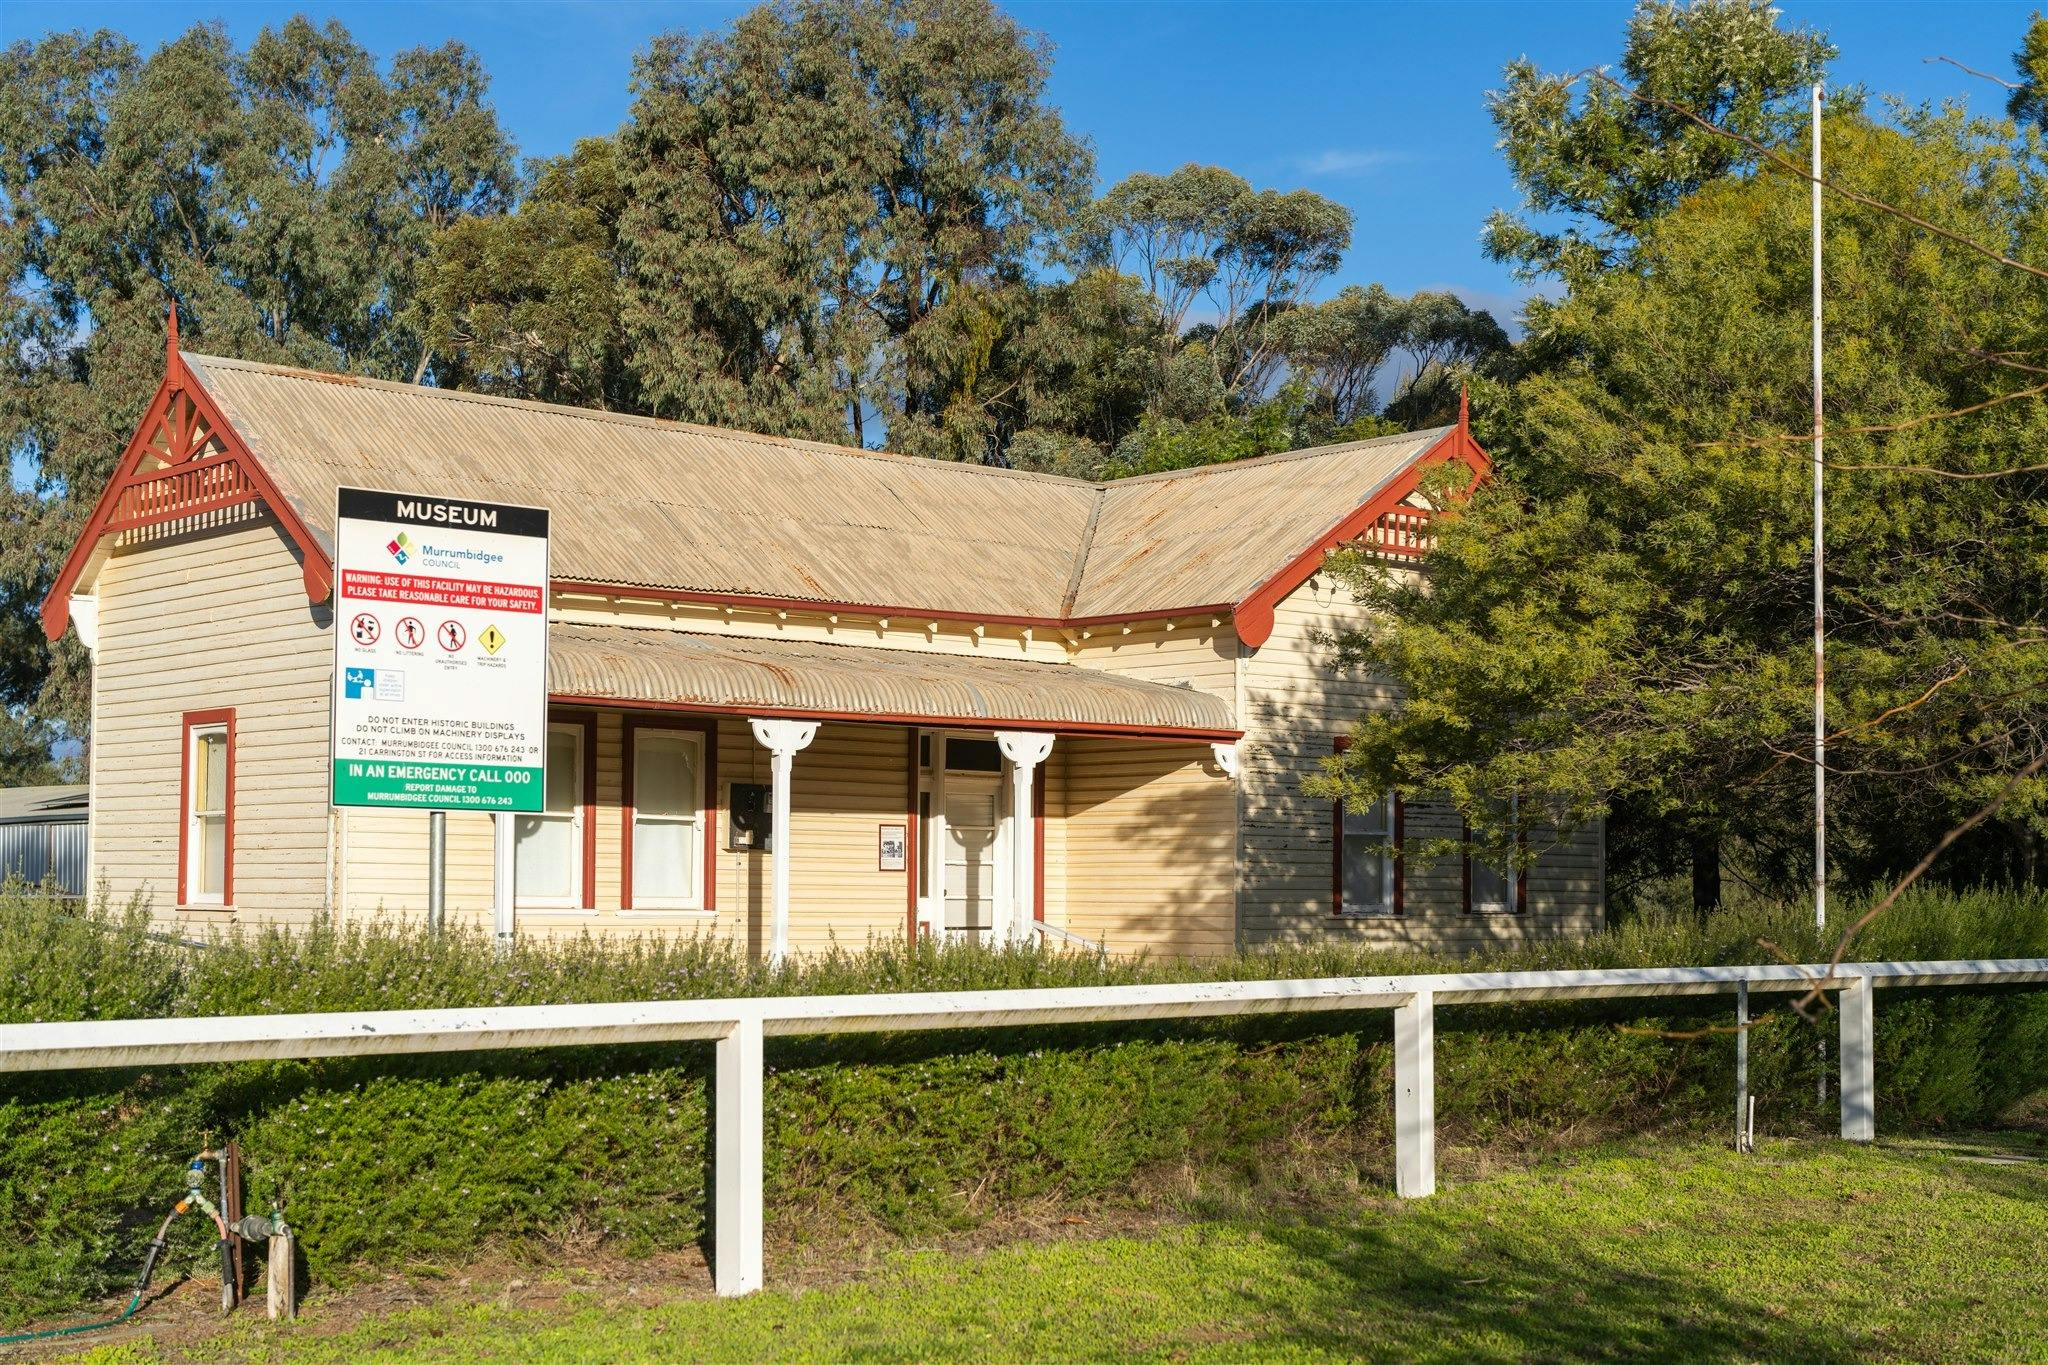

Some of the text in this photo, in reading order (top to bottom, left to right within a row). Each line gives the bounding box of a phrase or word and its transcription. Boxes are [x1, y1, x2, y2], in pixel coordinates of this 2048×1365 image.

[397, 501, 497, 527] MUSEUM
[423, 545, 503, 563] Murrumbidgee
[423, 559, 460, 569] COUNCIL
[345, 573, 539, 599] WARNING: USE OF THIS FACILITY MAY BE HAZARDOUS.
[348, 586, 538, 611] PLEASE TAKE REASONABLE CARE FOR YOUR SAFETY.
[402, 718, 429, 726] ENTER
[432, 720, 468, 728] HISTORIC
[472, 722, 514, 730] BUILDINGS
[390, 727, 416, 735] CLIMB
[433, 729, 482, 738] MACHINERY
[485, 731, 525, 740] DISPLAYS
[342, 738, 377, 746] CONTACT:
[382, 740, 439, 749] MURRUMBIDGEE
[442, 742, 472, 751] COUNCIL
[476, 744, 492, 752] 1300
[369, 748, 415, 757] CARRINGTON
[445, 751, 473, 760] ACCESS
[475, 753, 522, 762] INFORMATION
[349, 764, 530, 784] IN AN EMERGENCY CALL 000
[405, 783, 477, 794] REPORT DAMAGE TO
[368, 792, 513, 805] MURRUMBIDGEE COUNCIL 1300 676 243
